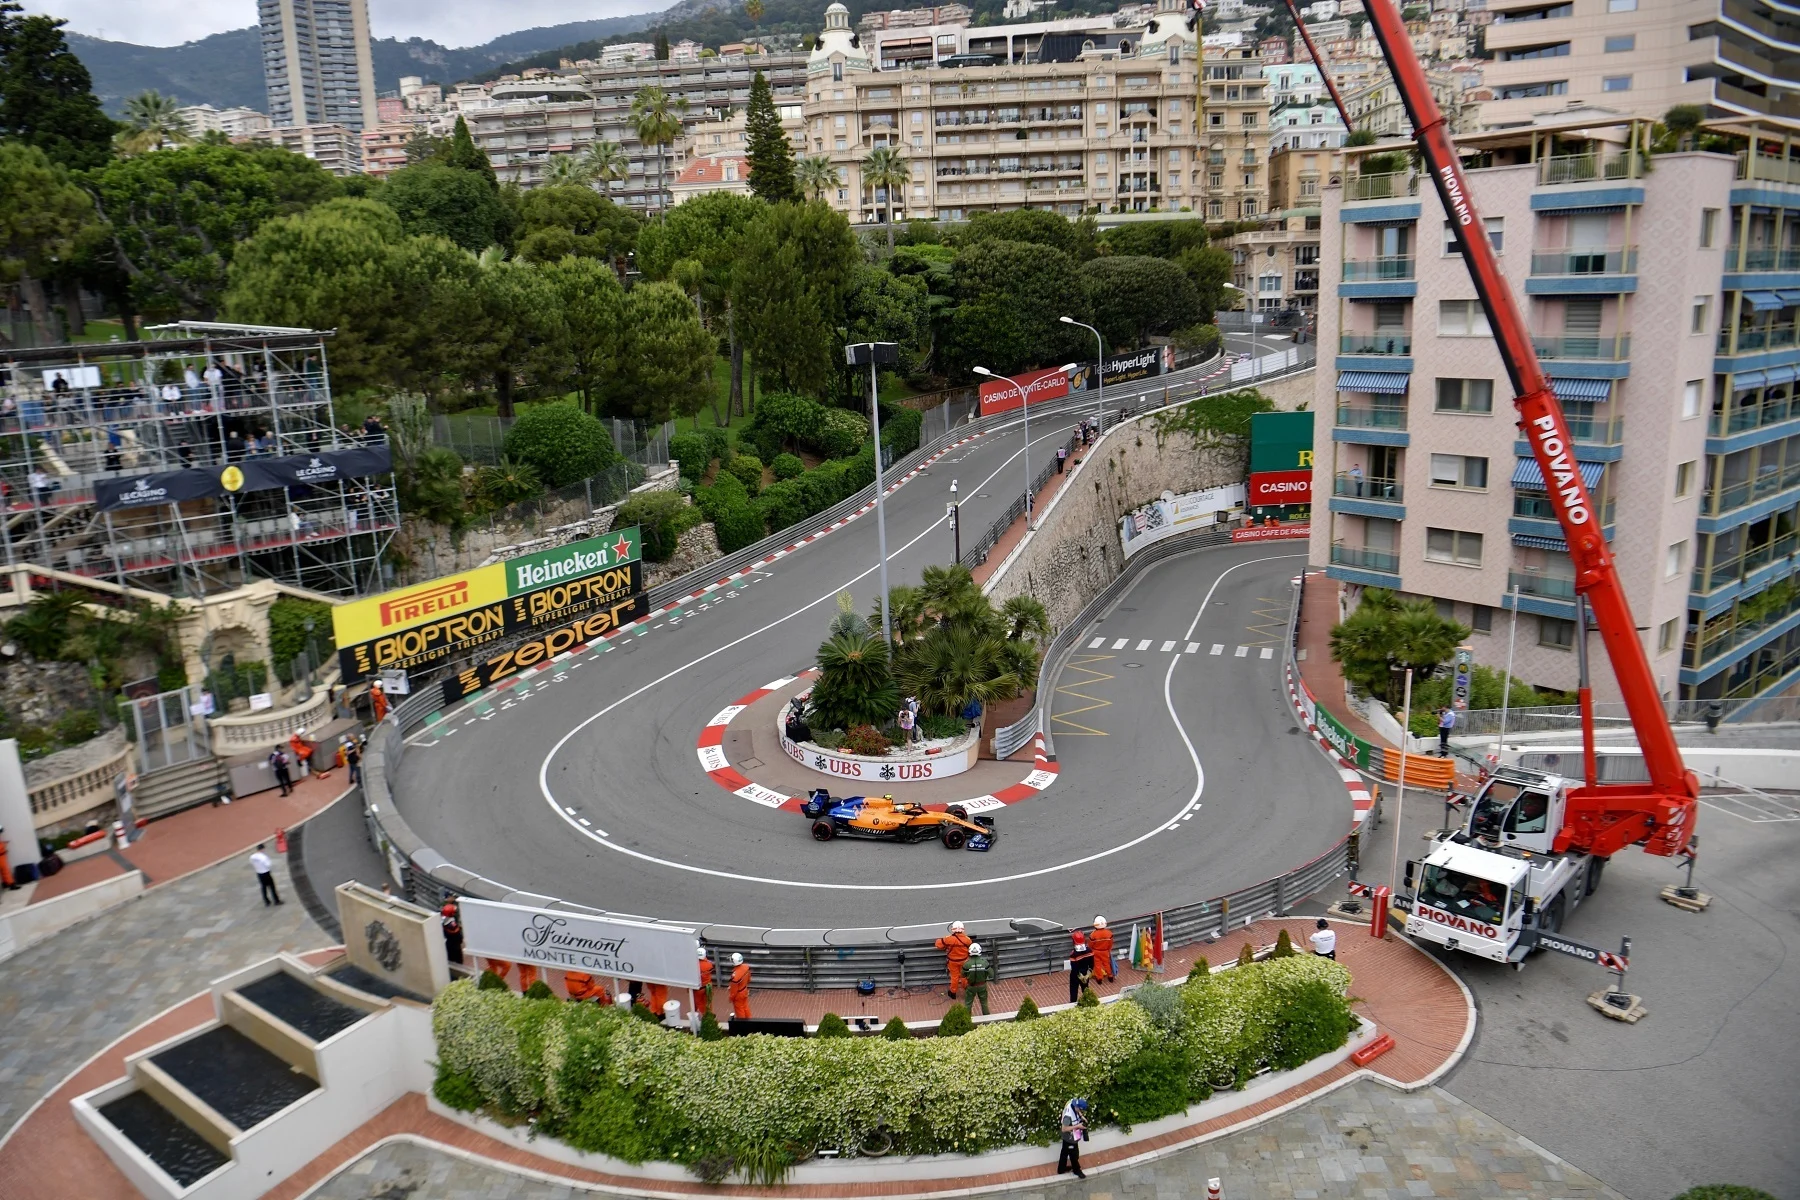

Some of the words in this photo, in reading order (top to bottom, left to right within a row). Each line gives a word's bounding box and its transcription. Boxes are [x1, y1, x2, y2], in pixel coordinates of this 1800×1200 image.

[1440, 165, 1472, 226] PIOVANO
[983, 390, 1008, 404] CASINO
[1008, 388, 1018, 398] DE
[1019, 376, 1066, 396] MONTE-CARLO
[1533, 414, 1590, 525] PIOVANO
[1259, 481, 1308, 494] CASINO
[1235, 530, 1261, 539] CASINO
[1261, 528, 1279, 538] CAFE
[1279, 528, 1290, 536] DE
[516, 547, 609, 590] Heineken
[379, 580, 470, 628] PIRELLI
[530, 565, 631, 617] BIOPTRON
[532, 600, 592, 626] HYPERLIGHT
[594, 587, 632, 610] THERAPY
[374, 604, 505, 666] BIOPTRON
[457, 627, 505, 651] THERAPY
[487, 598, 635, 683] zepter
[785, 741, 805, 763] UBS
[829, 757, 862, 777] UBS
[898, 762, 933, 780] UBS
[755, 791, 785, 805] UBS
[968, 796, 999, 810] UBS
[521, 914, 629, 958] Fairmont
[1418, 905, 1498, 940] PIOVANO
[523, 947, 577, 965] MONTE
[581, 955, 635, 974] CARLO
[1540, 937, 1596, 961] PIOVANO
